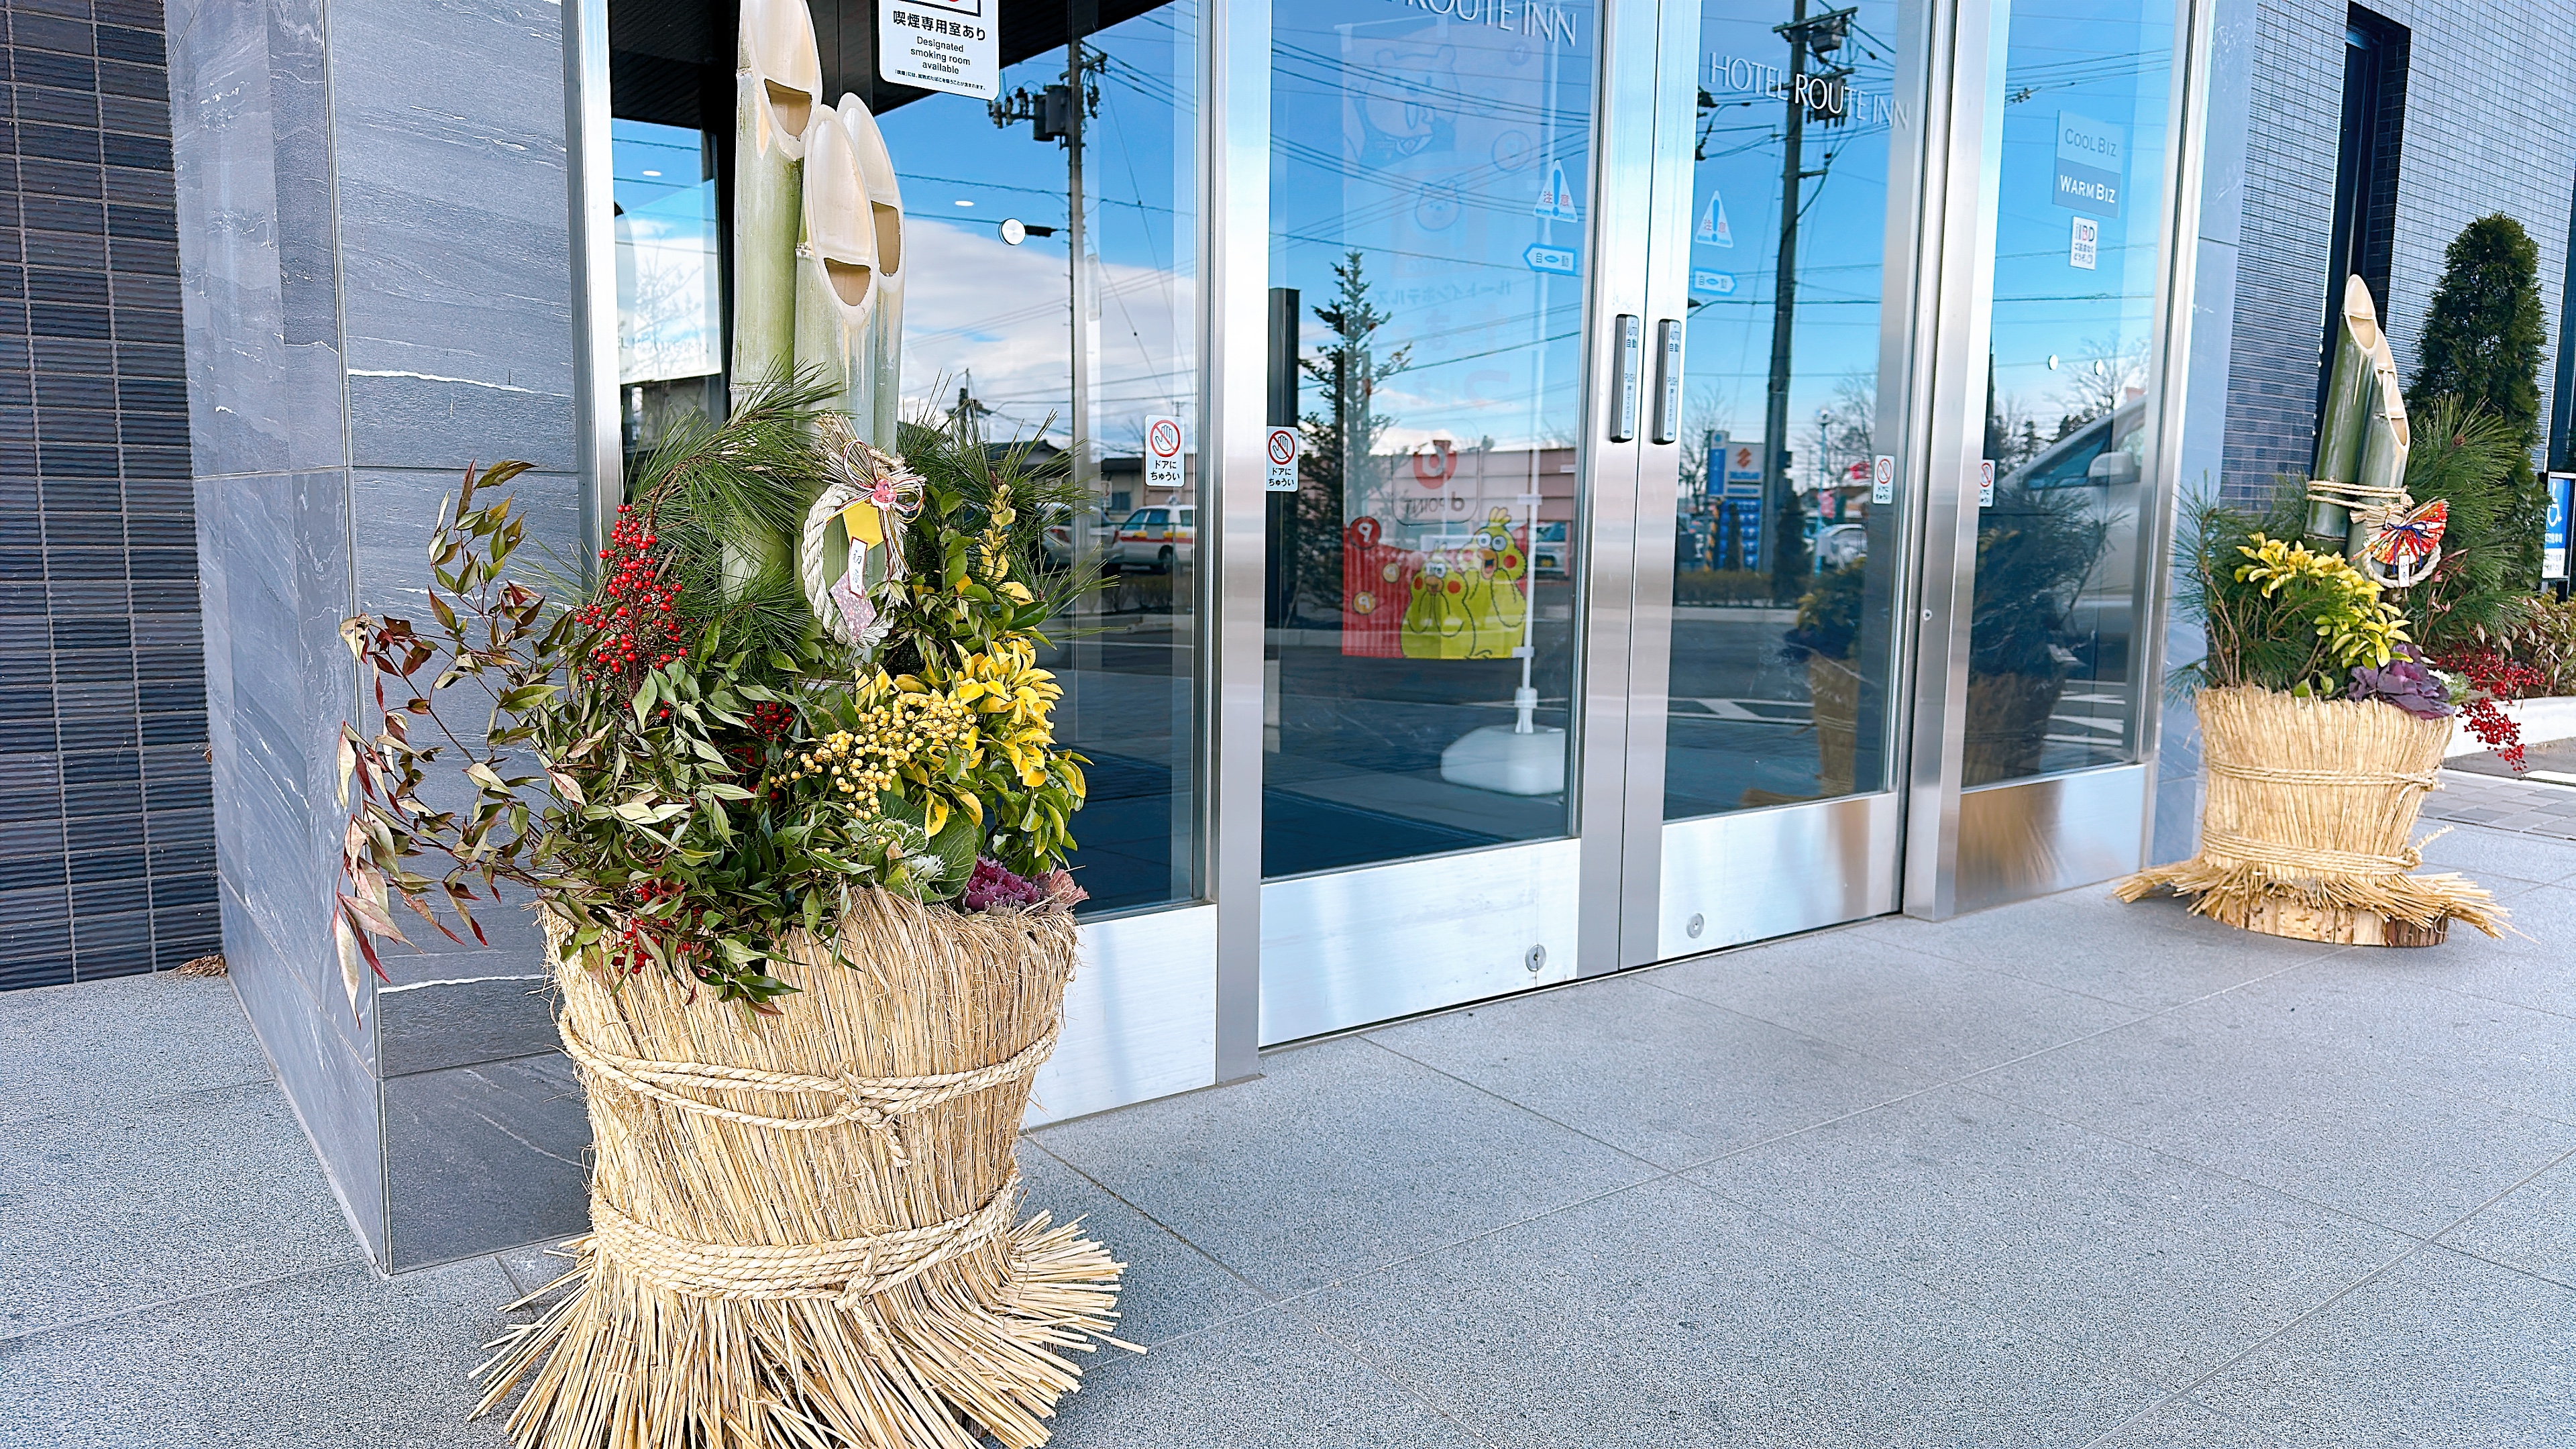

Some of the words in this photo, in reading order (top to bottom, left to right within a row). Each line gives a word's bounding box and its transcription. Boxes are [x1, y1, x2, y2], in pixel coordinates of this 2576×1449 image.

[893, 10, 986, 41] 喫煙専用室あり
[1407, 0, 1513, 32] UTE
[1522, 0, 1576, 47] INN
[917, 36, 964, 52] Designated
[910, 48, 947, 62] smoking
[949, 56, 971, 66] room
[922, 60, 959, 74] available
[1710, 52, 1788, 101] HOTEL
[1794, 73, 1868, 121] ROUTE
[1871, 94, 1910, 131] INN
[1625, 338, 1637, 348] 自動
[1668, 343, 1679, 352] 自動
[1155, 460, 1177, 470] ドアに
[1150, 471, 1180, 482] ちゅうい
[1272, 468, 1292, 476] ドアに
[1269, 478, 1295, 487] ちゅうい
